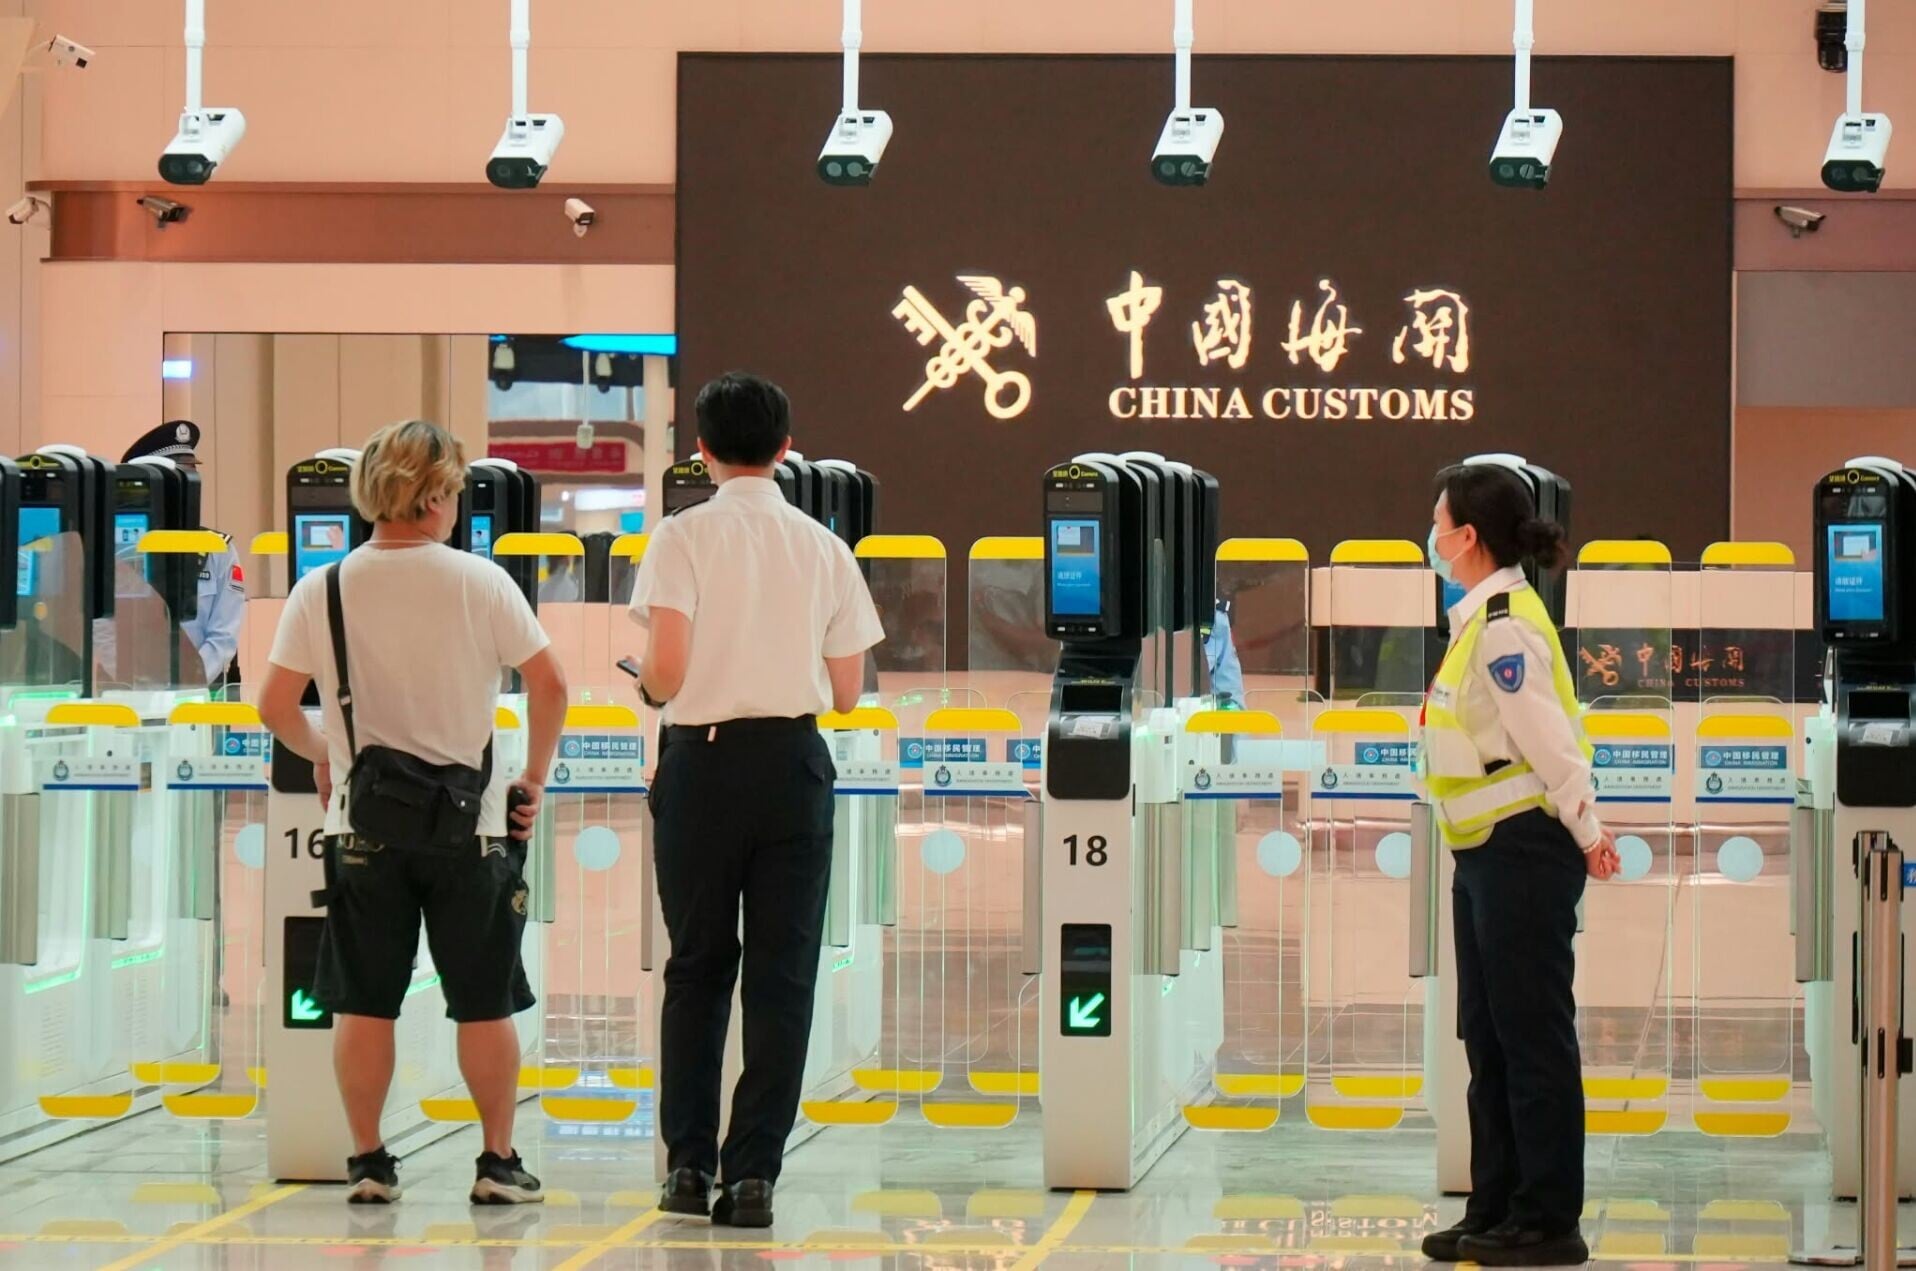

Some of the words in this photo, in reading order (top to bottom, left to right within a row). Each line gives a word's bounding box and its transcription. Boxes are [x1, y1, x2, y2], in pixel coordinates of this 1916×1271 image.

[1108, 387, 1253, 419] CHINA
[1262, 387, 1475, 420] CUSTOMS
[1638, 678, 1675, 688] CHINA
[1684, 678, 1745, 688] CUSTOMS
[284, 828, 324, 859] 16
[1063, 834, 1108, 867] 18
